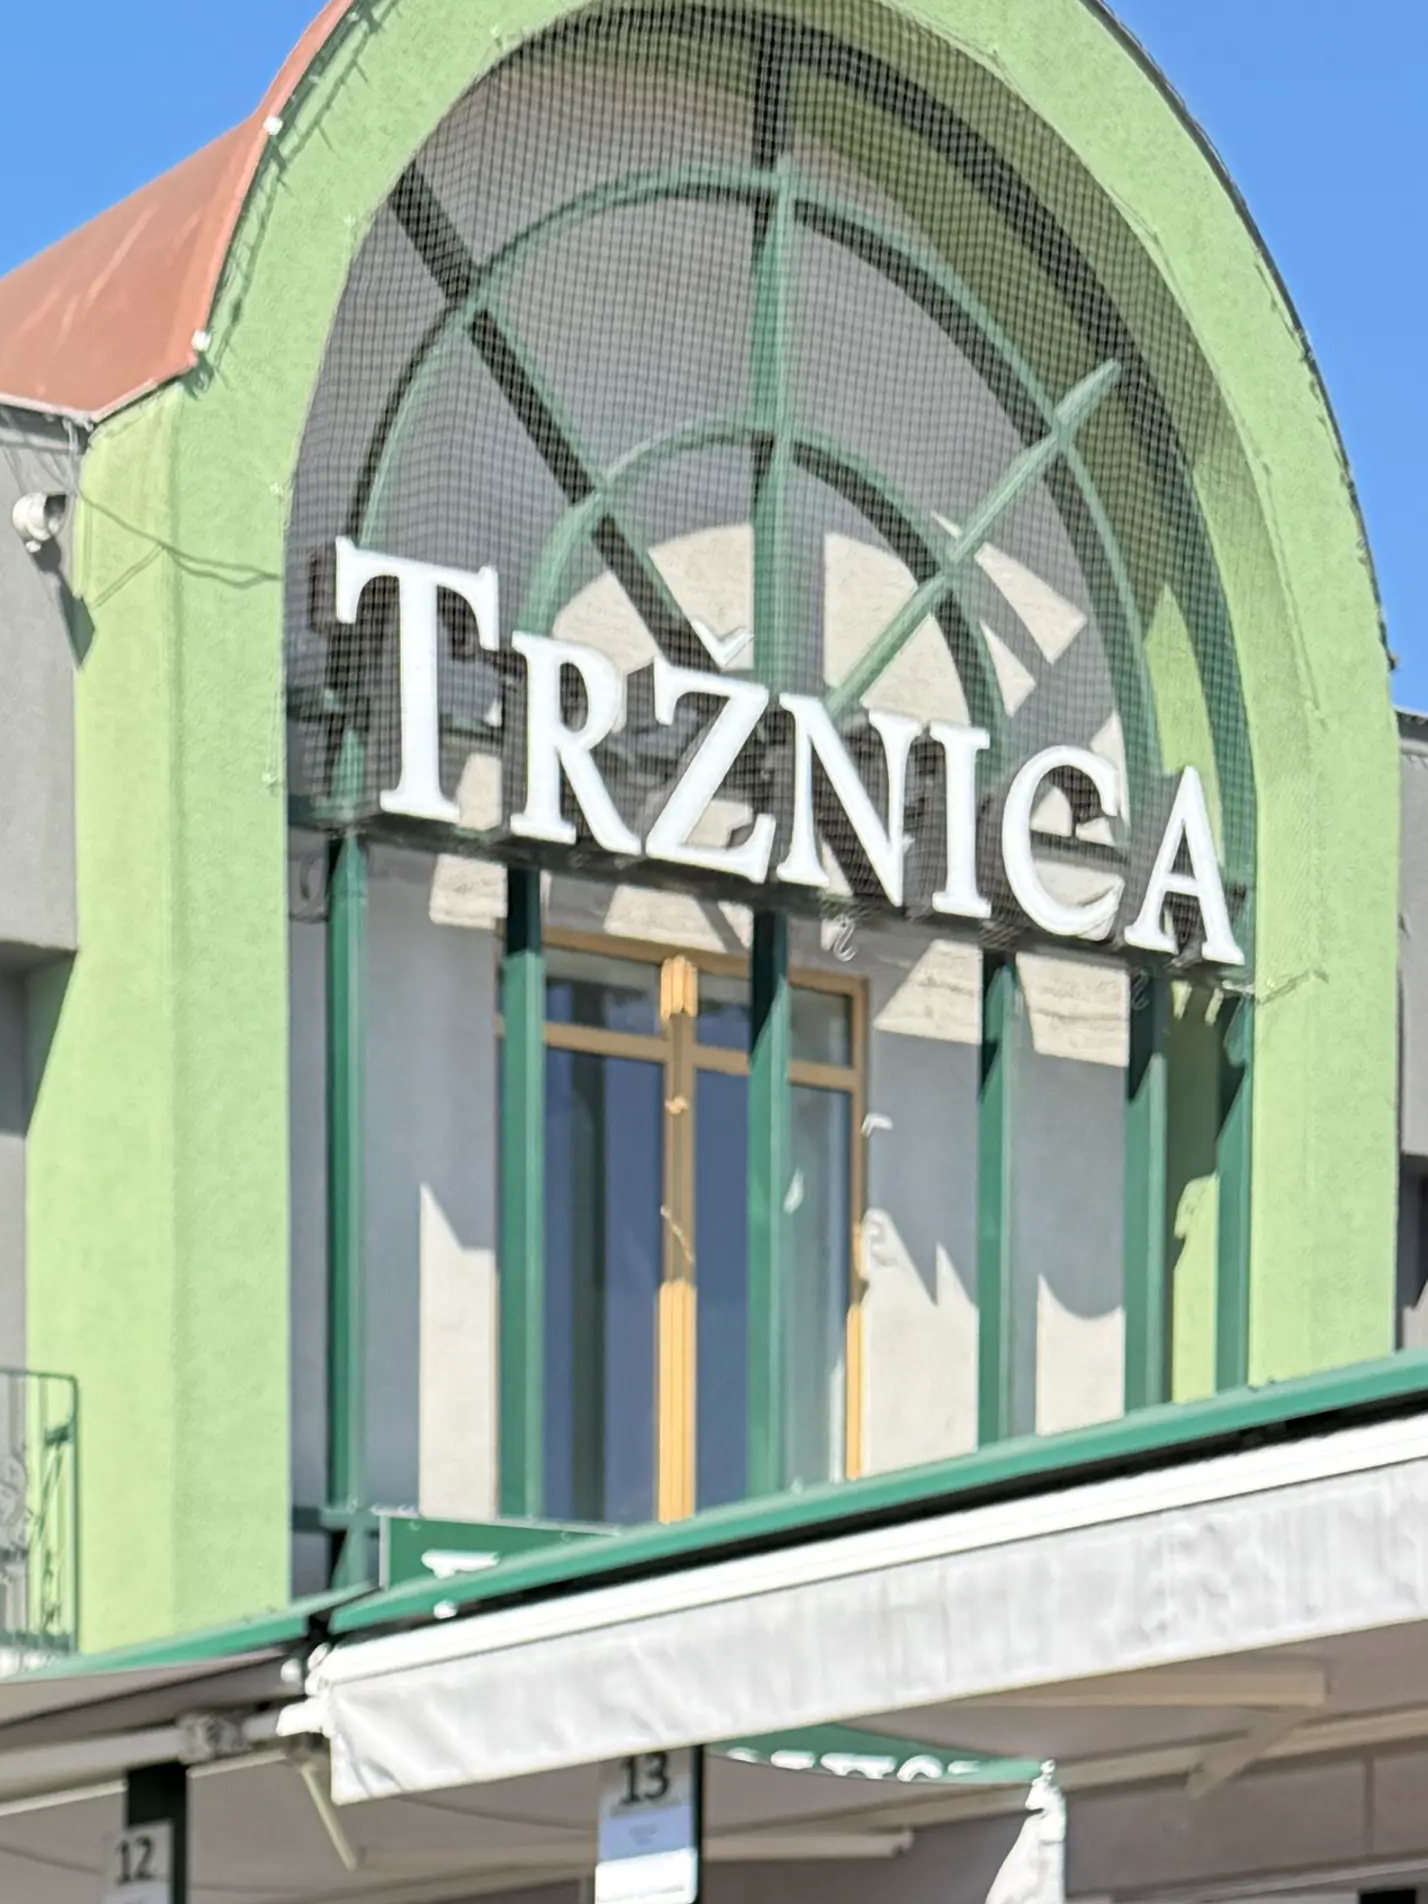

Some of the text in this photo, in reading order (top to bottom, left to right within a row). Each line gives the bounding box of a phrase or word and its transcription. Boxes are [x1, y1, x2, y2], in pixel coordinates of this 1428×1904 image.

[334, 537, 1245, 966] TRŽNICA
[619, 1750, 670, 1807] 13
[115, 1835, 157, 1888] 12
